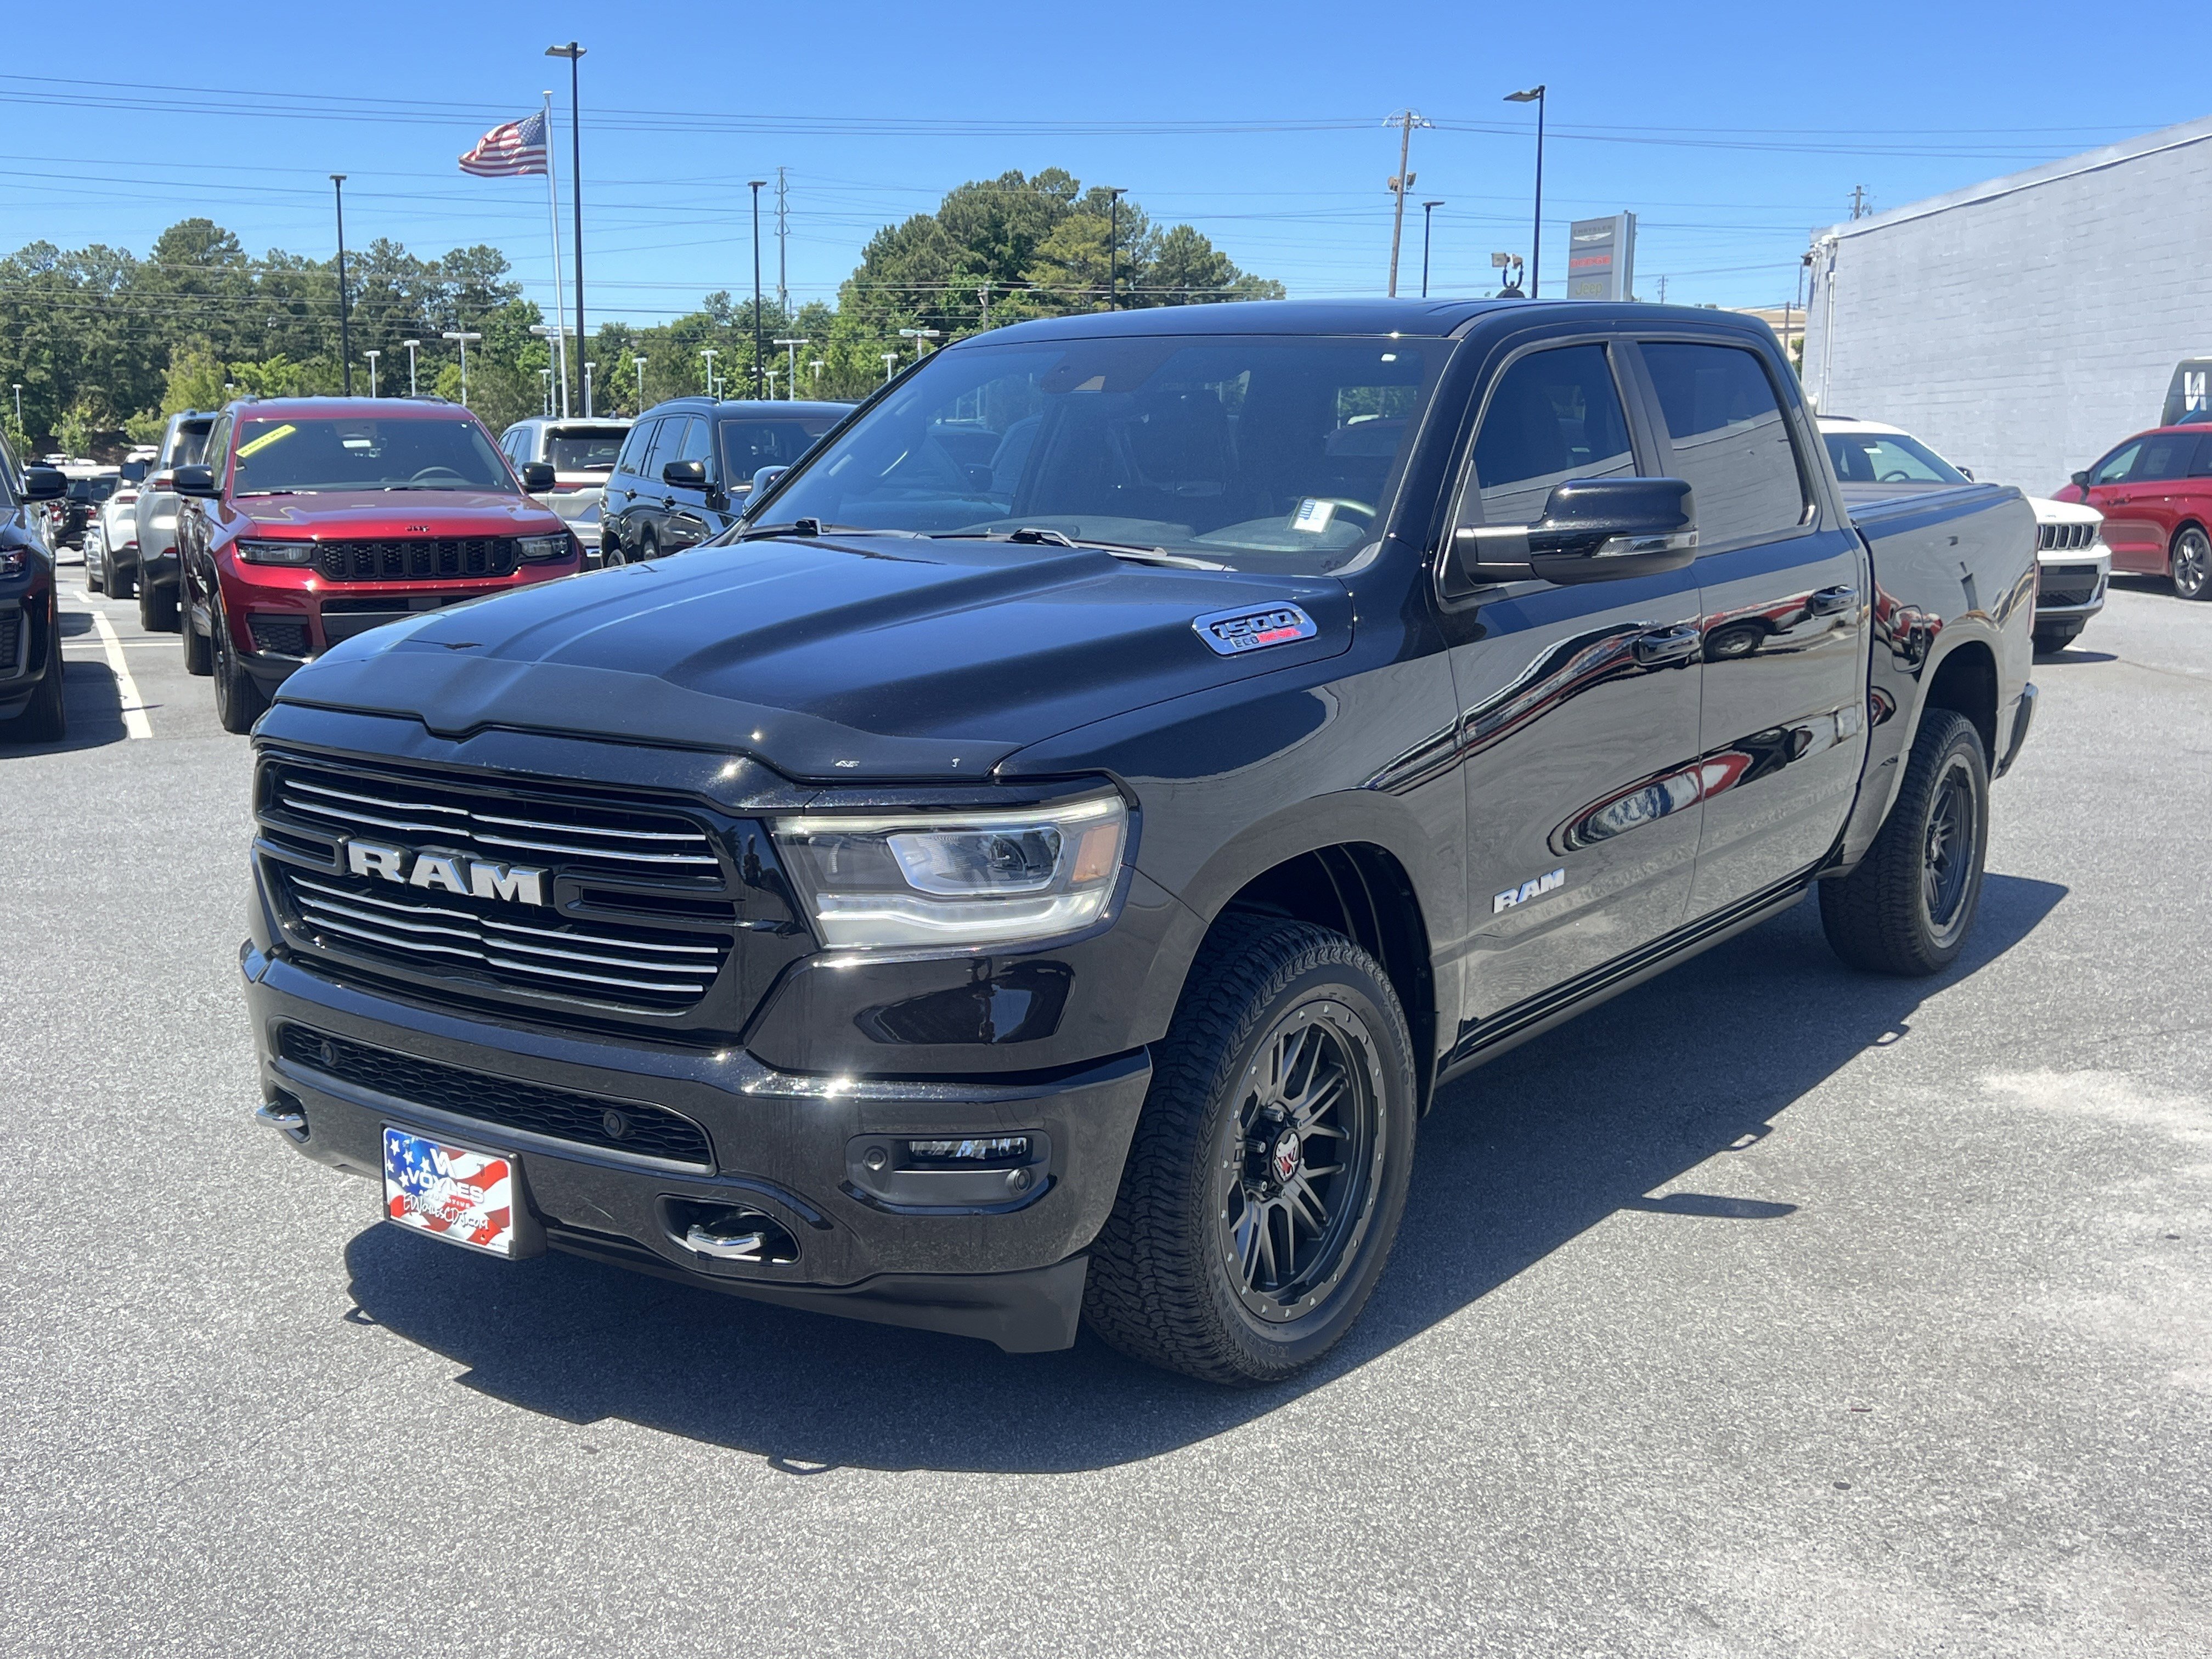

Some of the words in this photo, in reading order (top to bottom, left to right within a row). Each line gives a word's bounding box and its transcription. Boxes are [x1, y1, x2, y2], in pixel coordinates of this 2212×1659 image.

[1575, 280, 1603, 298] Jeep
[1211, 610, 1296, 640] 1500
[348, 838, 548, 906] RAM
[1492, 867, 1565, 914] RAM
[406, 1166, 484, 1204] VOYLES
